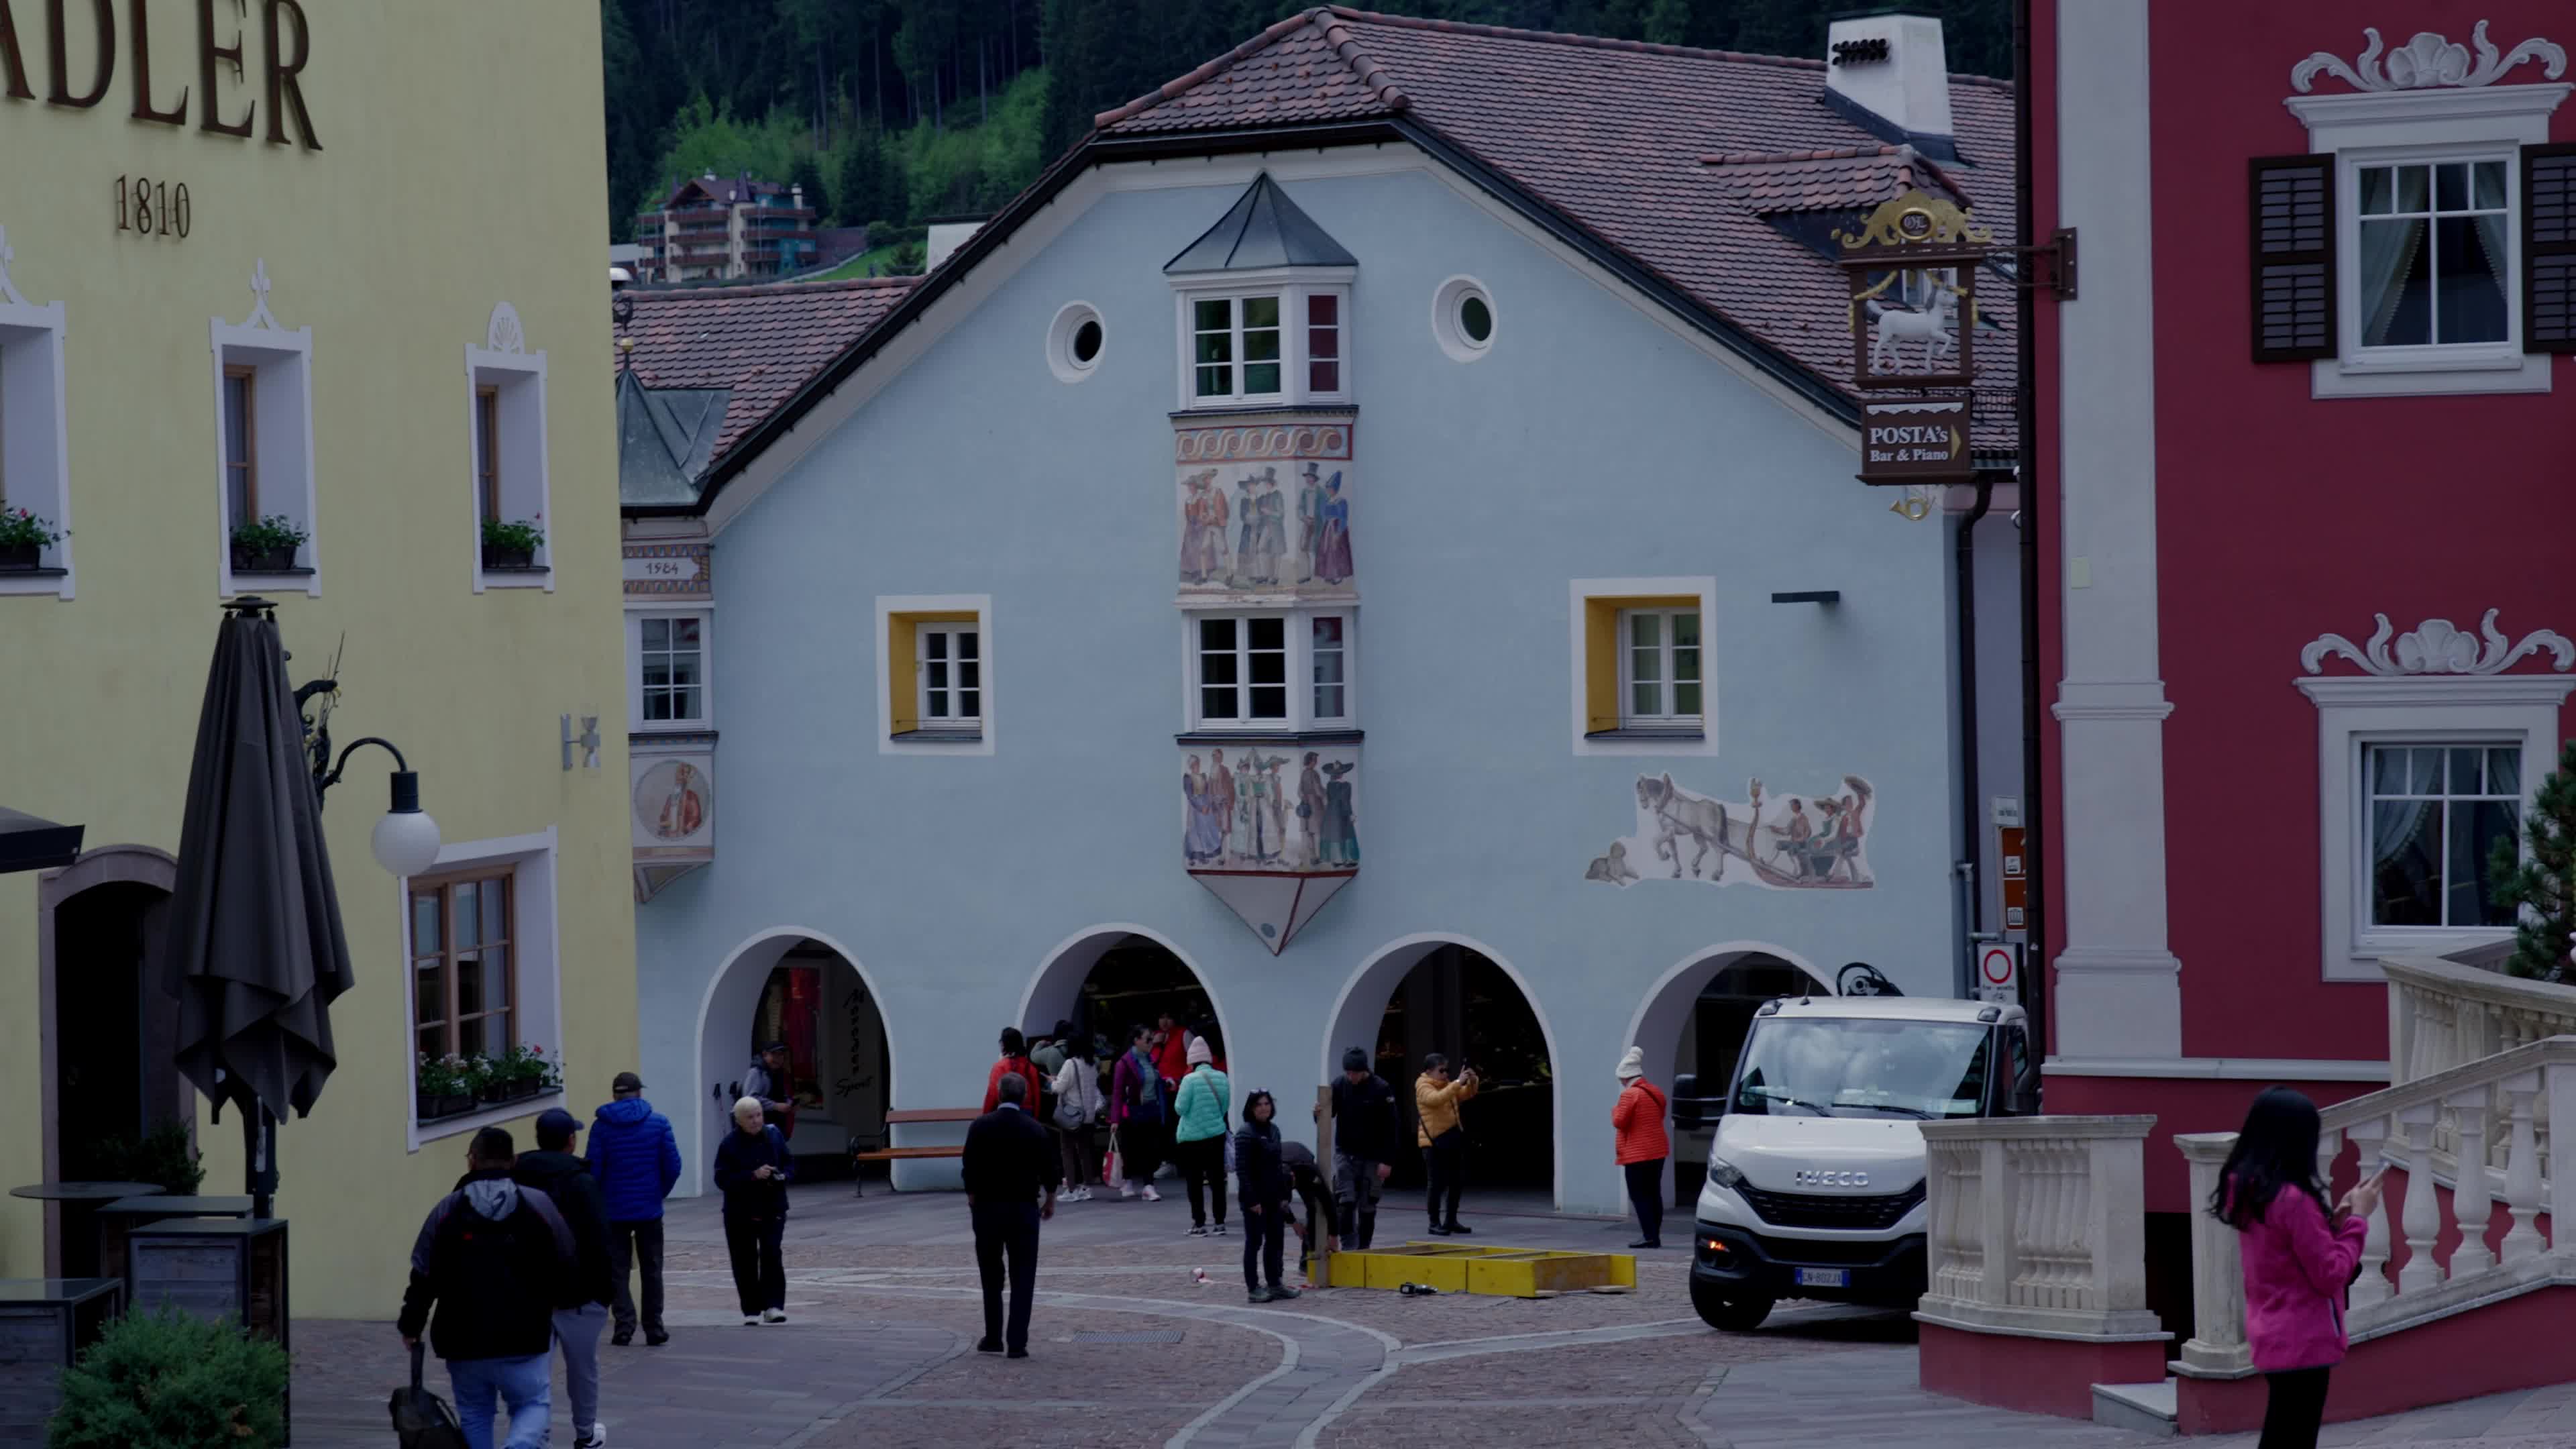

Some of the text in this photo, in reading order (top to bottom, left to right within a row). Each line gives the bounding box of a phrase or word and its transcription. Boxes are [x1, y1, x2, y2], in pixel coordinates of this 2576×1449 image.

[115, 174, 191, 238] 1810
[1870, 425, 1949, 445] POSTA's
[1870, 448, 1949, 462] Bar & Piano
[645, 561, 679, 575] 1984
[835, 1076, 873, 1098] Sport
[1796, 1169, 1869, 1187] IVECO
